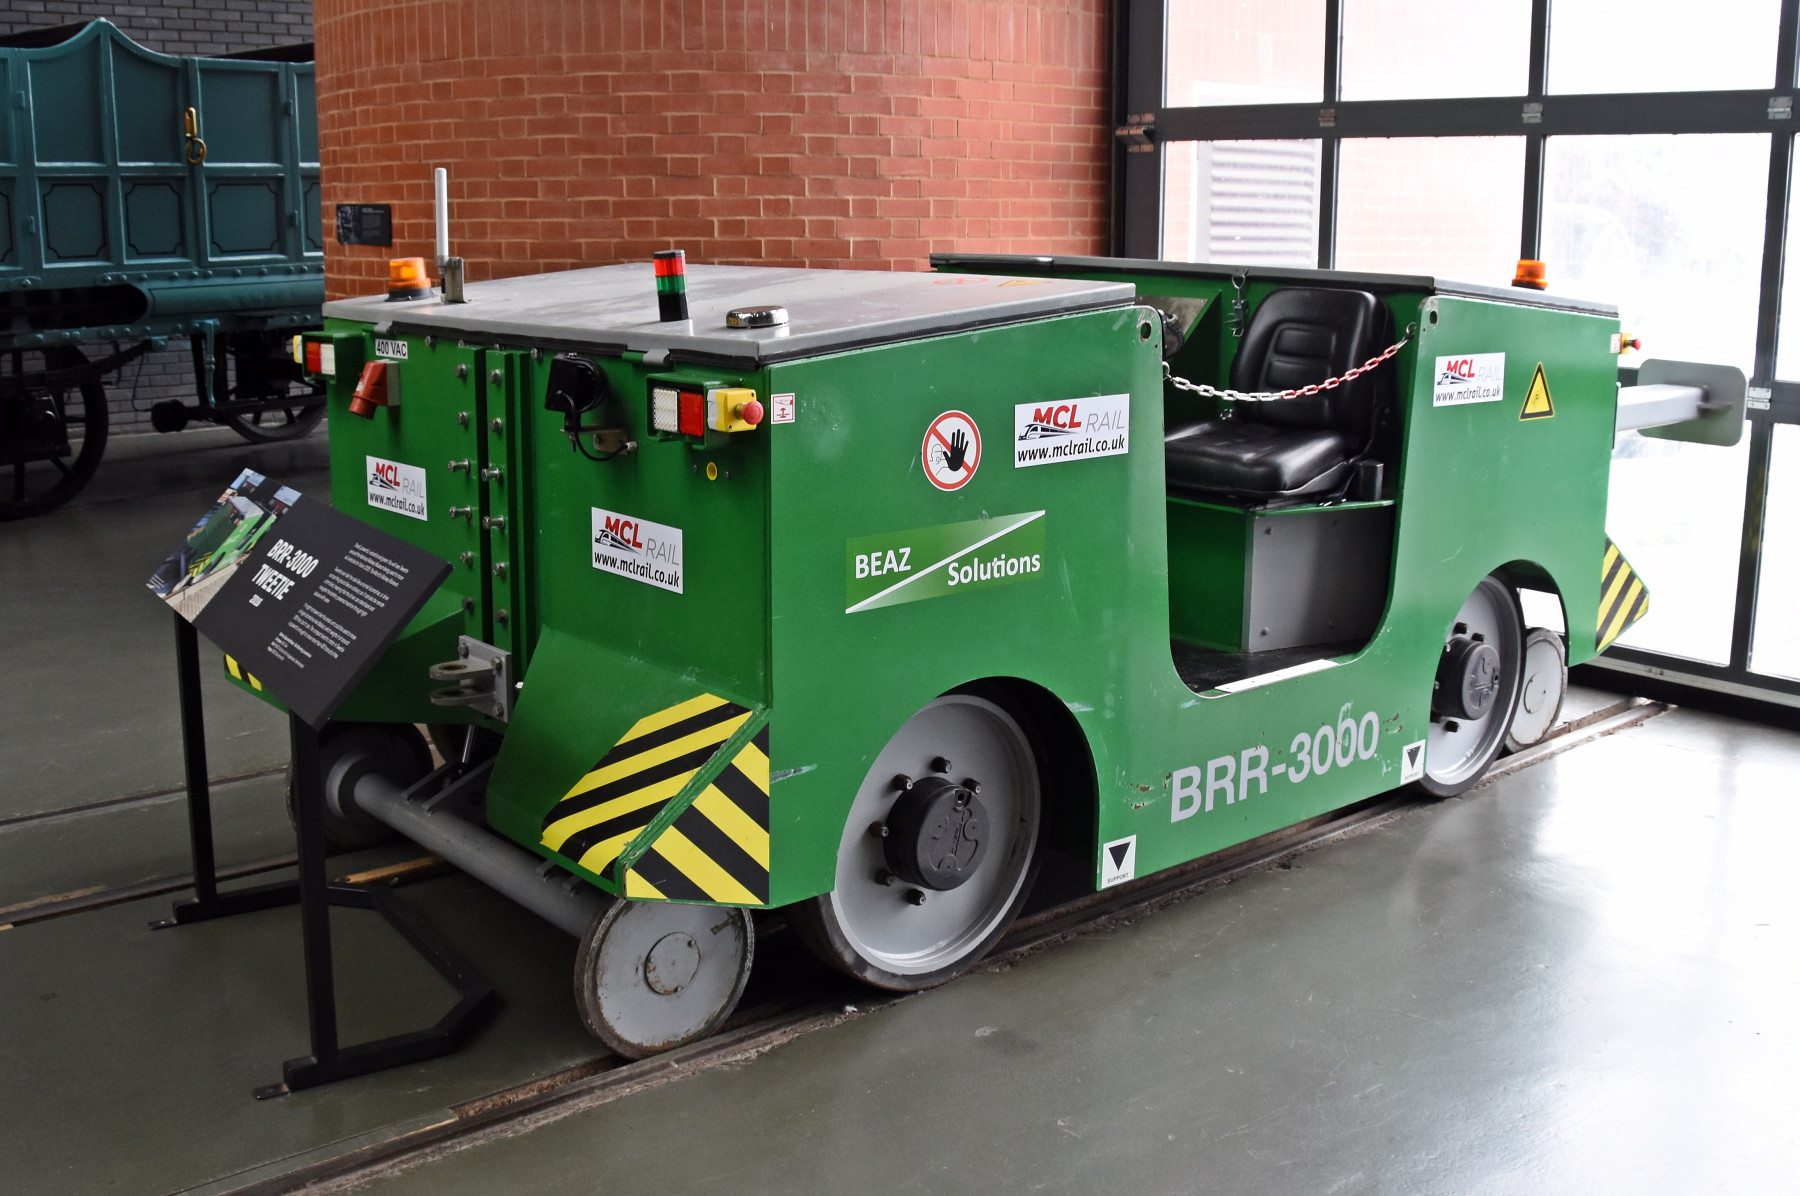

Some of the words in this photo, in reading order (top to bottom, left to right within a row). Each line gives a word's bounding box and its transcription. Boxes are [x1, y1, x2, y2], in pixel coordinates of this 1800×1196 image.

[377, 341, 390, 355] 400
[390, 342, 407, 357] VAC
[1446, 359, 1475, 378] MCL
[1477, 366, 1502, 382] RAIL
[1435, 385, 1501, 402] www.mclrail.co.uk
[1033, 404, 1082, 429] MCL
[1085, 410, 1126, 433] RAIL
[1017, 434, 1126, 462] www.mclrail.co.uk
[375, 461, 401, 487] MCL
[402, 477, 425, 499] RAIL
[369, 492, 425, 516] www.mclrail.co.uk
[605, 515, 643, 549] MCL
[645, 537, 680, 566] RAIL
[266, 538, 319, 578] BRR-3000
[594, 551, 680, 588] www.mclrail.co.uk
[855, 547, 912, 579] BEAZ
[947, 554, 1041, 586] Solutions
[251, 563, 296, 601] TWEETIE
[248, 594, 264, 607] 20
[1170, 711, 1380, 824] BRR-3000
[1107, 872, 1129, 884] SUPPORT
